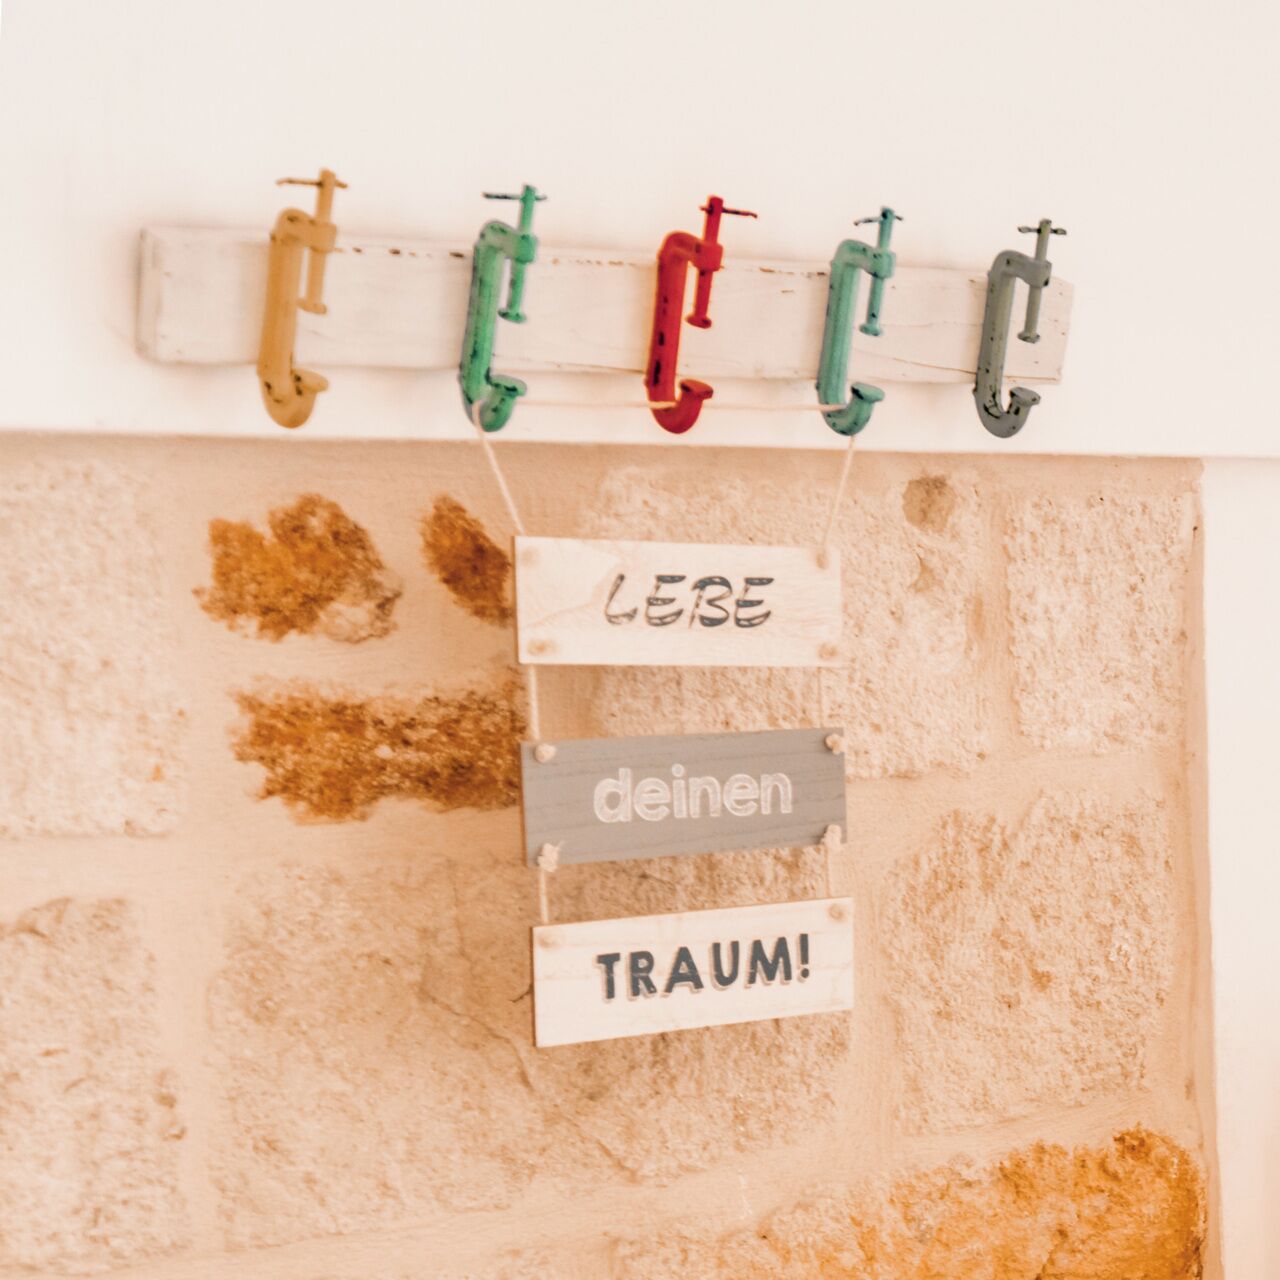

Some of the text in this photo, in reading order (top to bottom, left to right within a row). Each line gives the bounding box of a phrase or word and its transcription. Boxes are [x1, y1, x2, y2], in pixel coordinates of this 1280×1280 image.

[605, 573, 775, 629] LEBE
[594, 764, 793, 823] deinen
[596, 933, 811, 1000] TRAUM!
